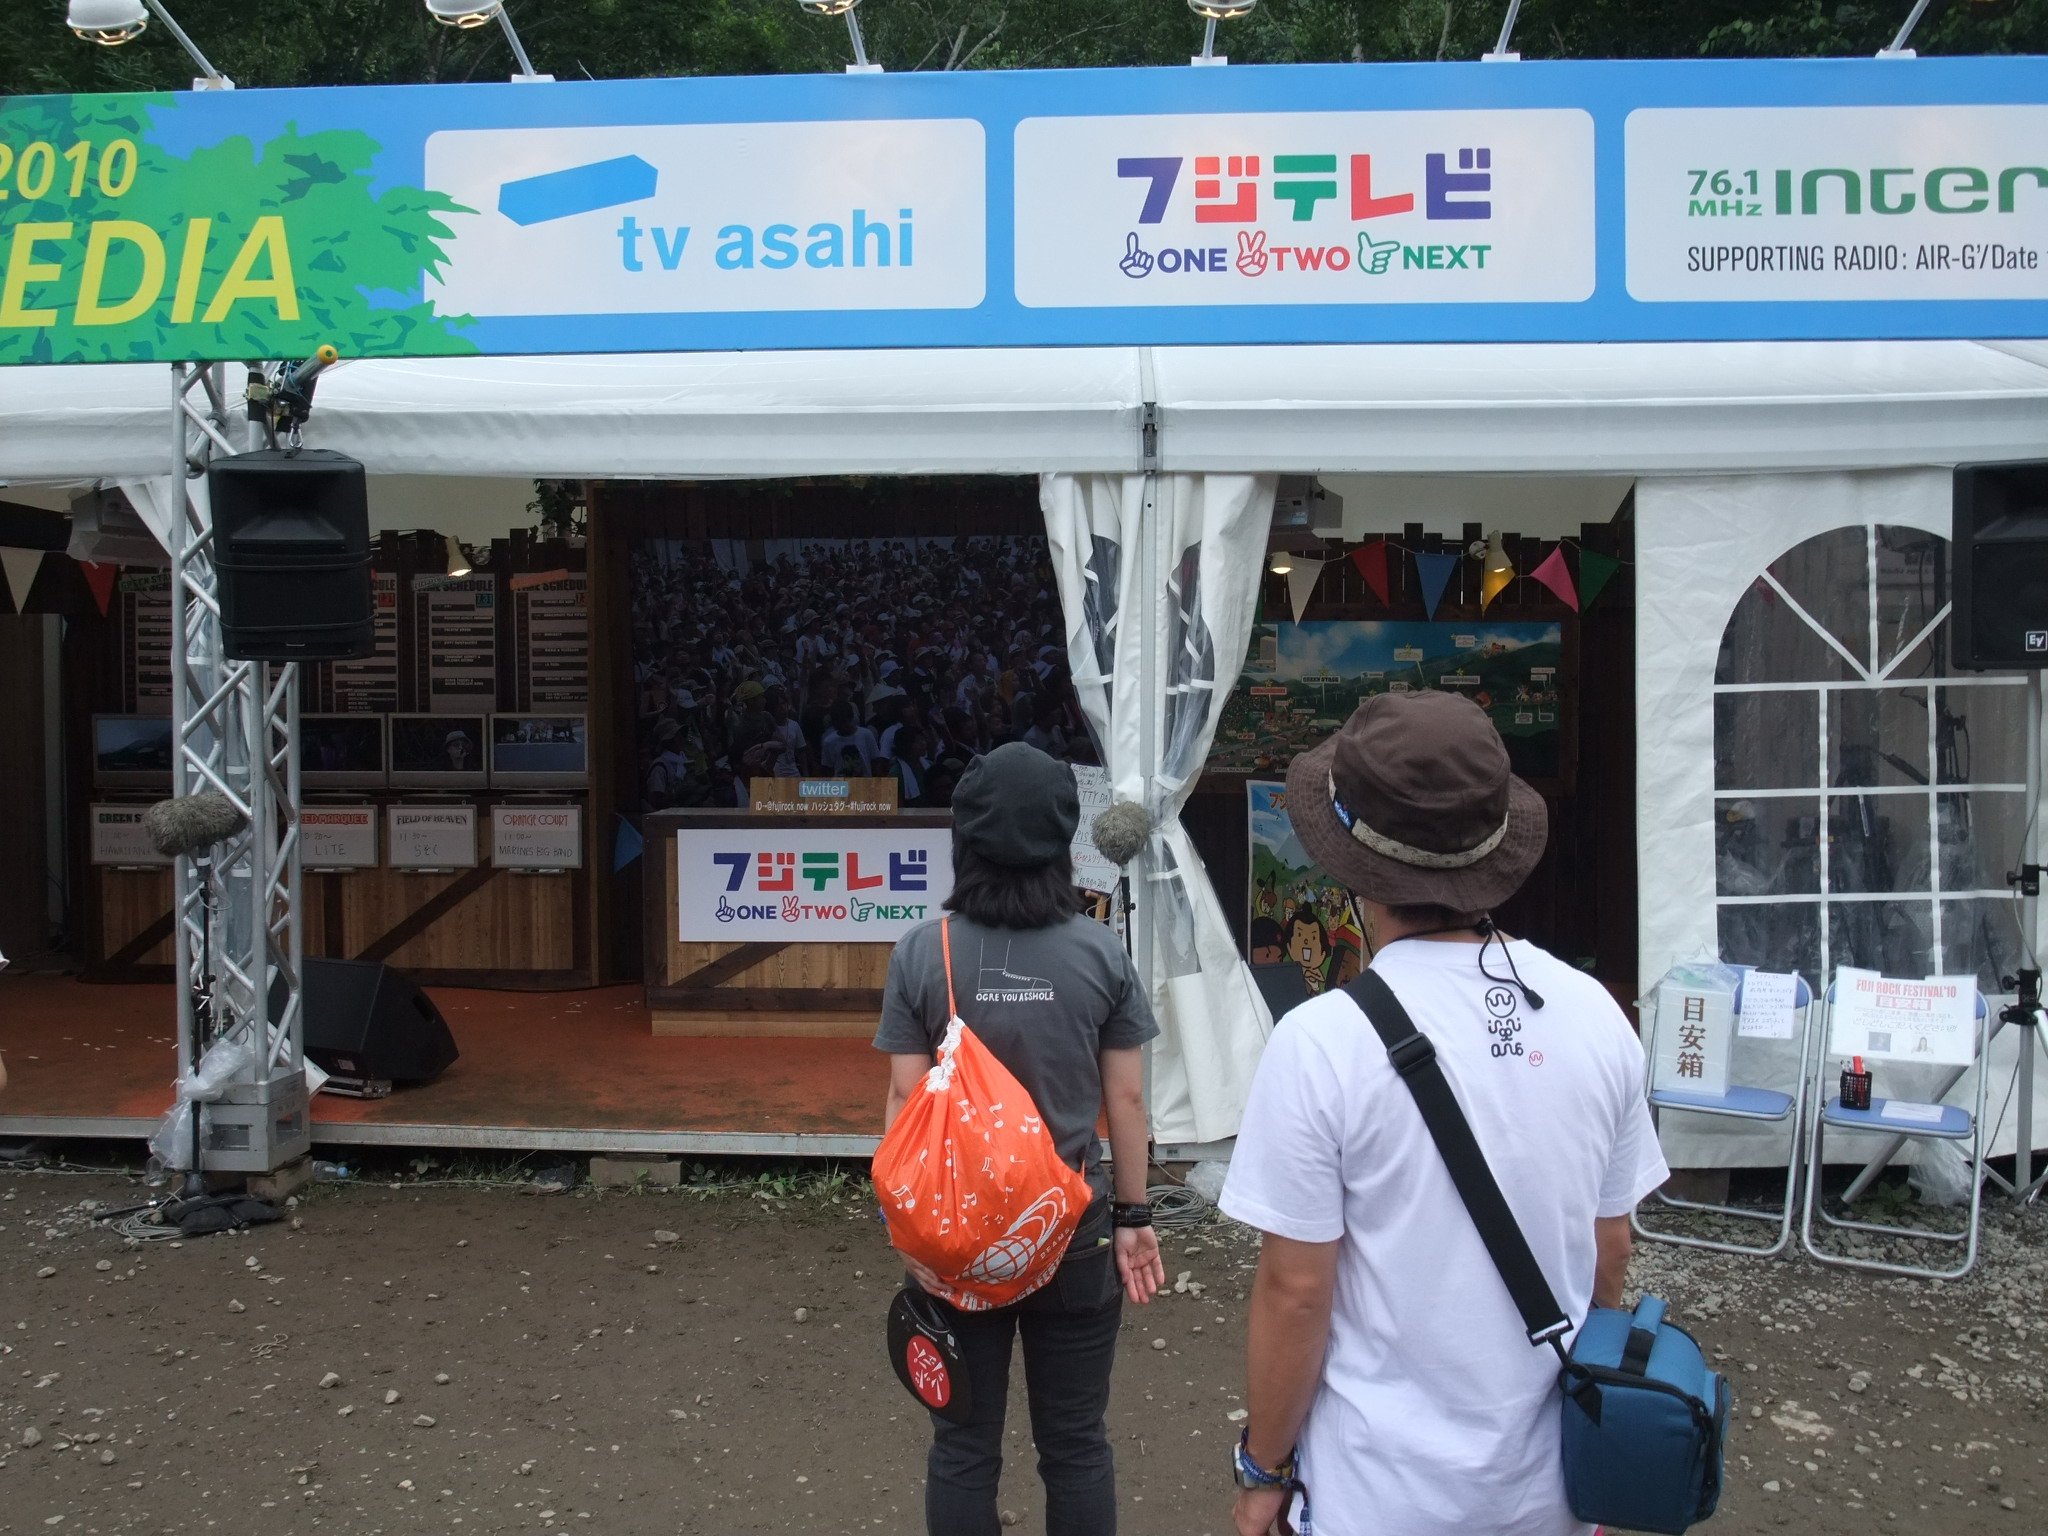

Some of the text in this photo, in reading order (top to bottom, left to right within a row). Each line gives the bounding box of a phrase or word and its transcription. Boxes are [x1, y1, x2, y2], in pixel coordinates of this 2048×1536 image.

[1117, 148, 1492, 225] フジテレビ
[1687, 169, 1758, 196] 76.1
[1687, 200, 1763, 217] MHz
[617, 208, 913, 272] tv asahi
[0, 215, 301, 328] EDIA
[1157, 245, 1492, 274] ONE TWO NEXT
[1687, 246, 1825, 272] SUPPORTING
[801, 782, 846, 796] twitter
[538, 814, 569, 827] COURT
[713, 850, 928, 892] フジテレビ
[736, 905, 928, 920] ONE TWO NEXT
[976, 992, 1055, 1002] OGRE YOU ASSHOLE
[1856, 980, 1875, 993] FUJI
[1877, 981, 1902, 996] ROCK
[1677, 996, 1706, 1078] 目安箱
